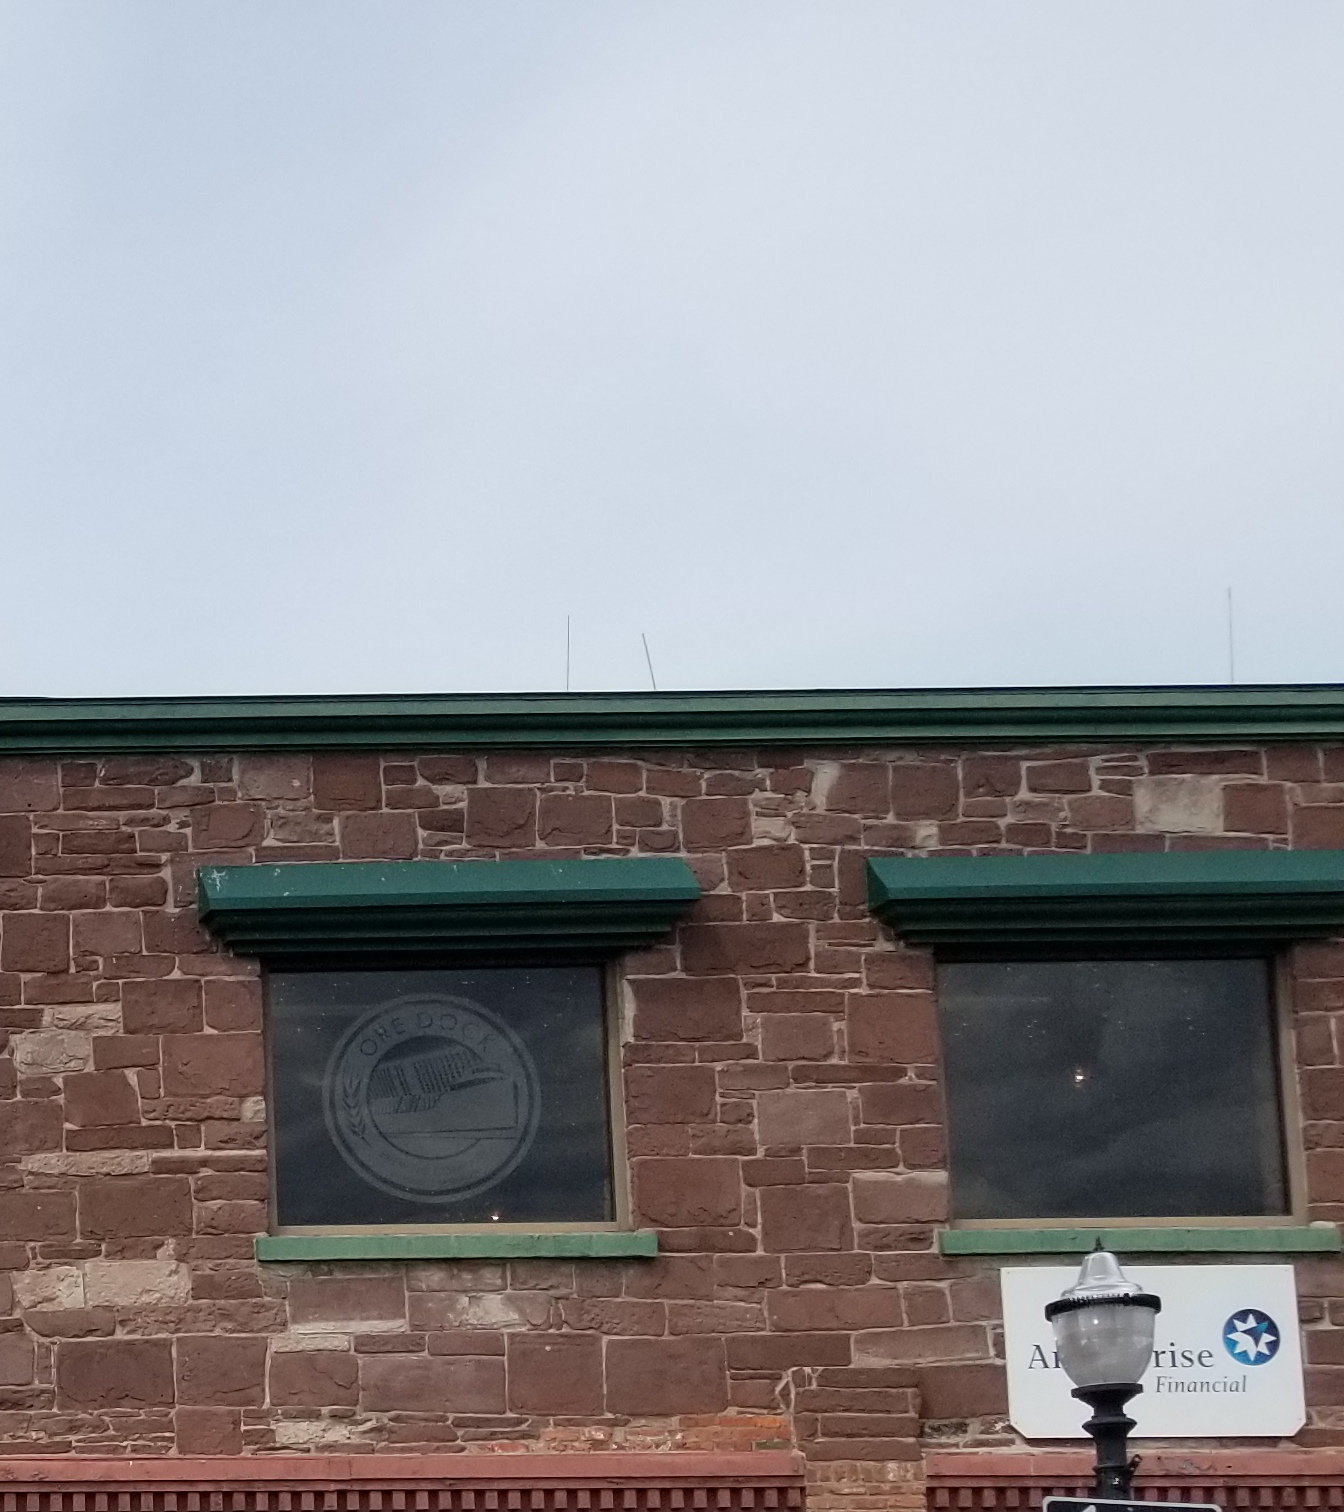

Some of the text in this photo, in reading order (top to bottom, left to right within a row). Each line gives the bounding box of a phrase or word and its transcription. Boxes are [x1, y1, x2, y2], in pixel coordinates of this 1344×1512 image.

[359, 1011, 499, 1057] ORE DOCK
[1155, 1374, 1248, 1393] Financial
